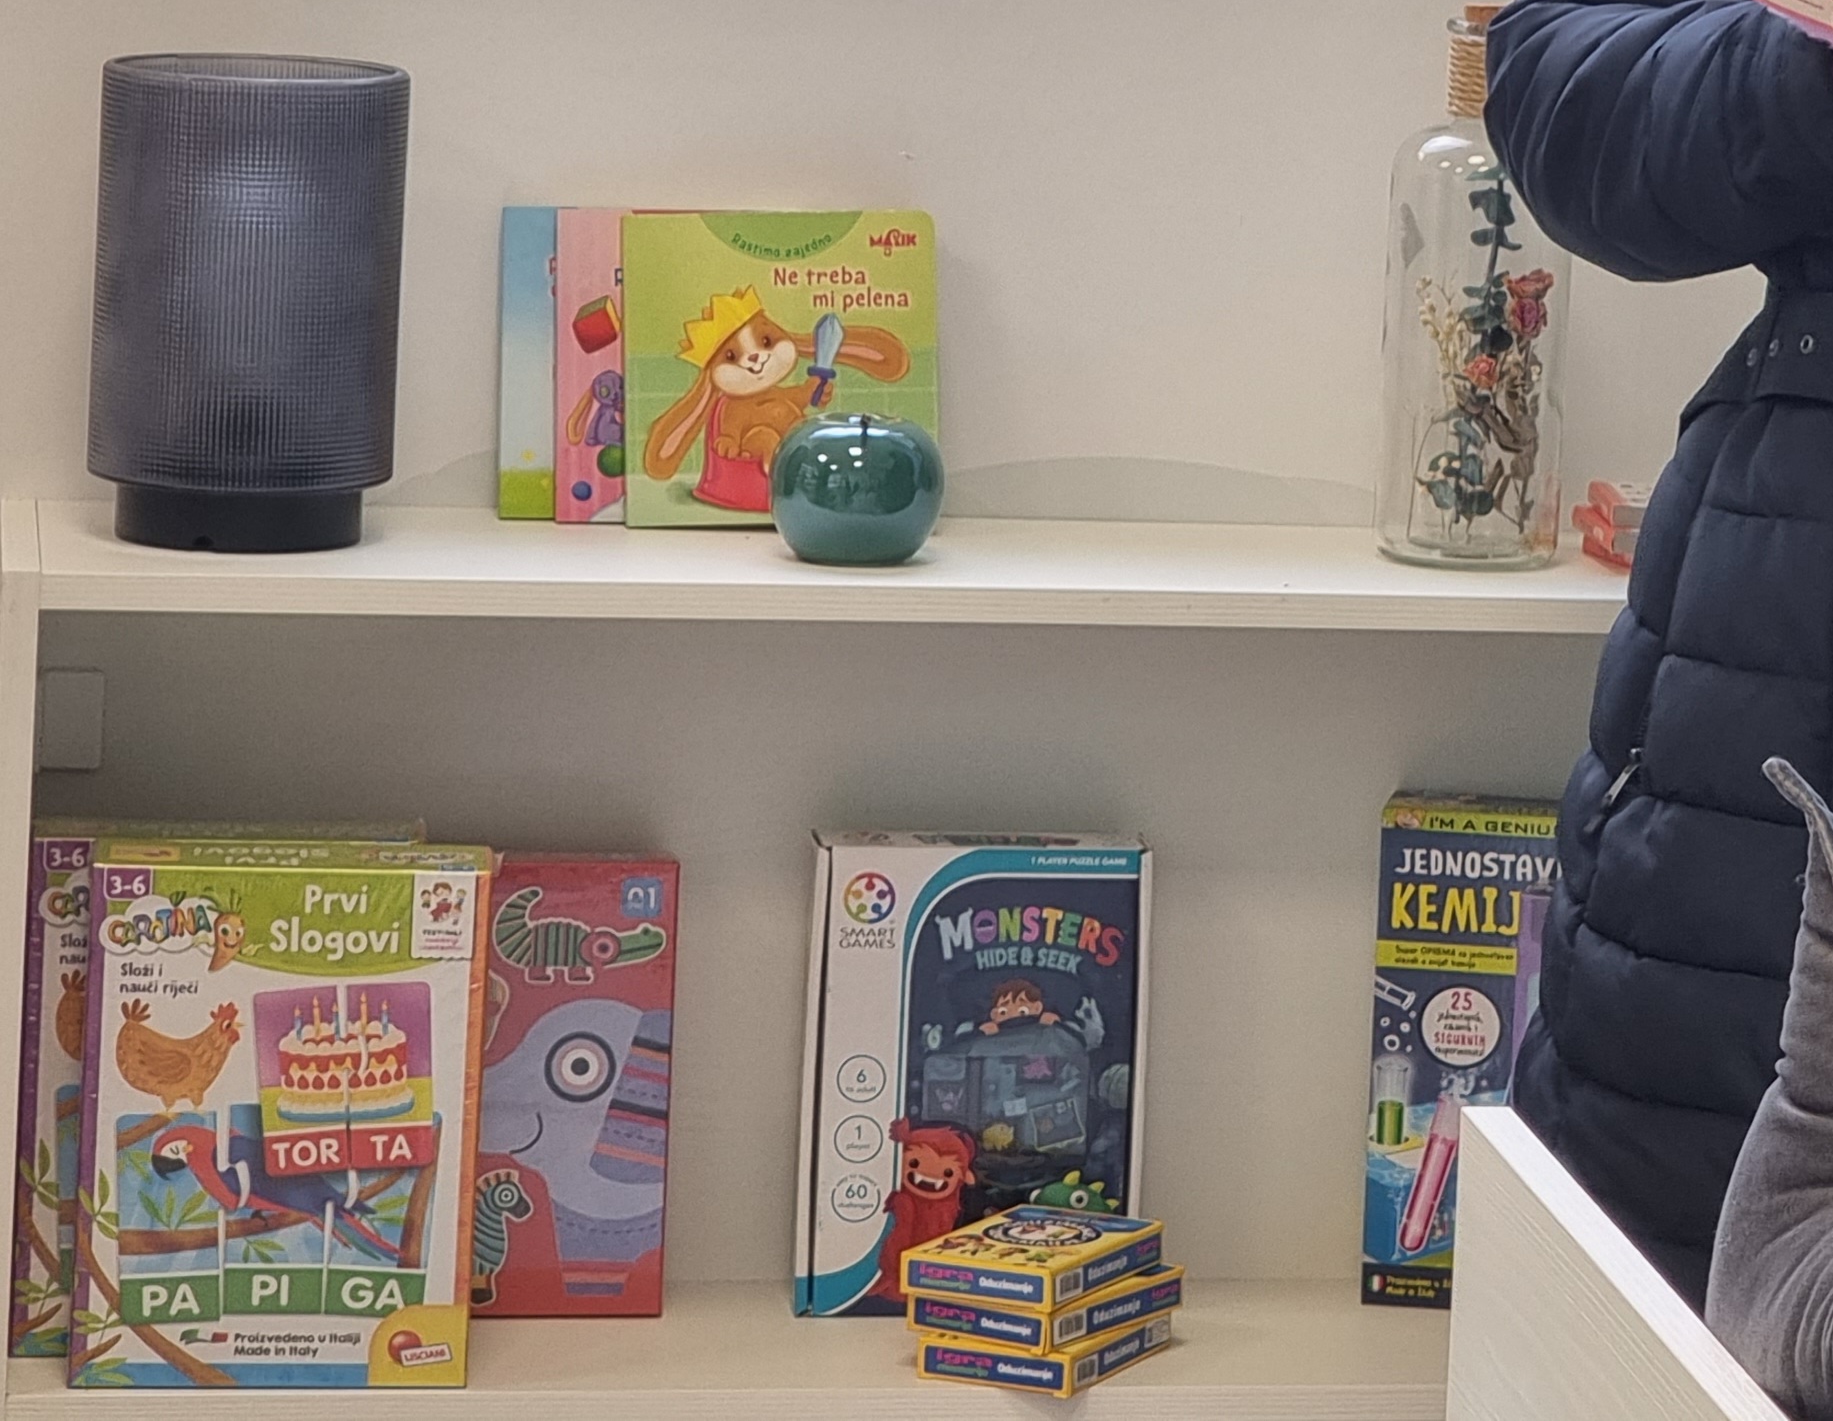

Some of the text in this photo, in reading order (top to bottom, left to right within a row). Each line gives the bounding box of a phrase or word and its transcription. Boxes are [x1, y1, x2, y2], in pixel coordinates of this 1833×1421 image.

[731, 233, 832, 258] Rastimo zajedno
[774, 266, 867, 286] Ne treba
[813, 286, 909, 313] mi pelena
[1429, 815, 1557, 837] I'M A GENIU
[50, 847, 85, 867] 3-6
[1394, 848, 1562, 882] JEDNOSTAV
[109, 875, 146, 896] 3-6
[304, 884, 368, 915] Prvi
[269, 916, 401, 961] Slogovi
[839, 927, 896, 939] SMART
[934, 906, 1125, 967] MONSTERS
[838, 938, 896, 950] GAMES
[59, 953, 87, 965] nau
[975, 947, 1084, 975] HIDE & SEEK
[1450, 990, 1473, 1011] 25
[856, 1069, 867, 1084] 6
[854, 1124, 862, 1140] 1
[271, 1133, 413, 1170] TOR TA
[845, 1183, 868, 1200] 60
[141, 1274, 406, 1318] PA PI GA
[233, 1332, 315, 1344] Proizvedeno
[318, 1334, 327, 1344] u
[233, 1345, 320, 1359] Made in Italy
